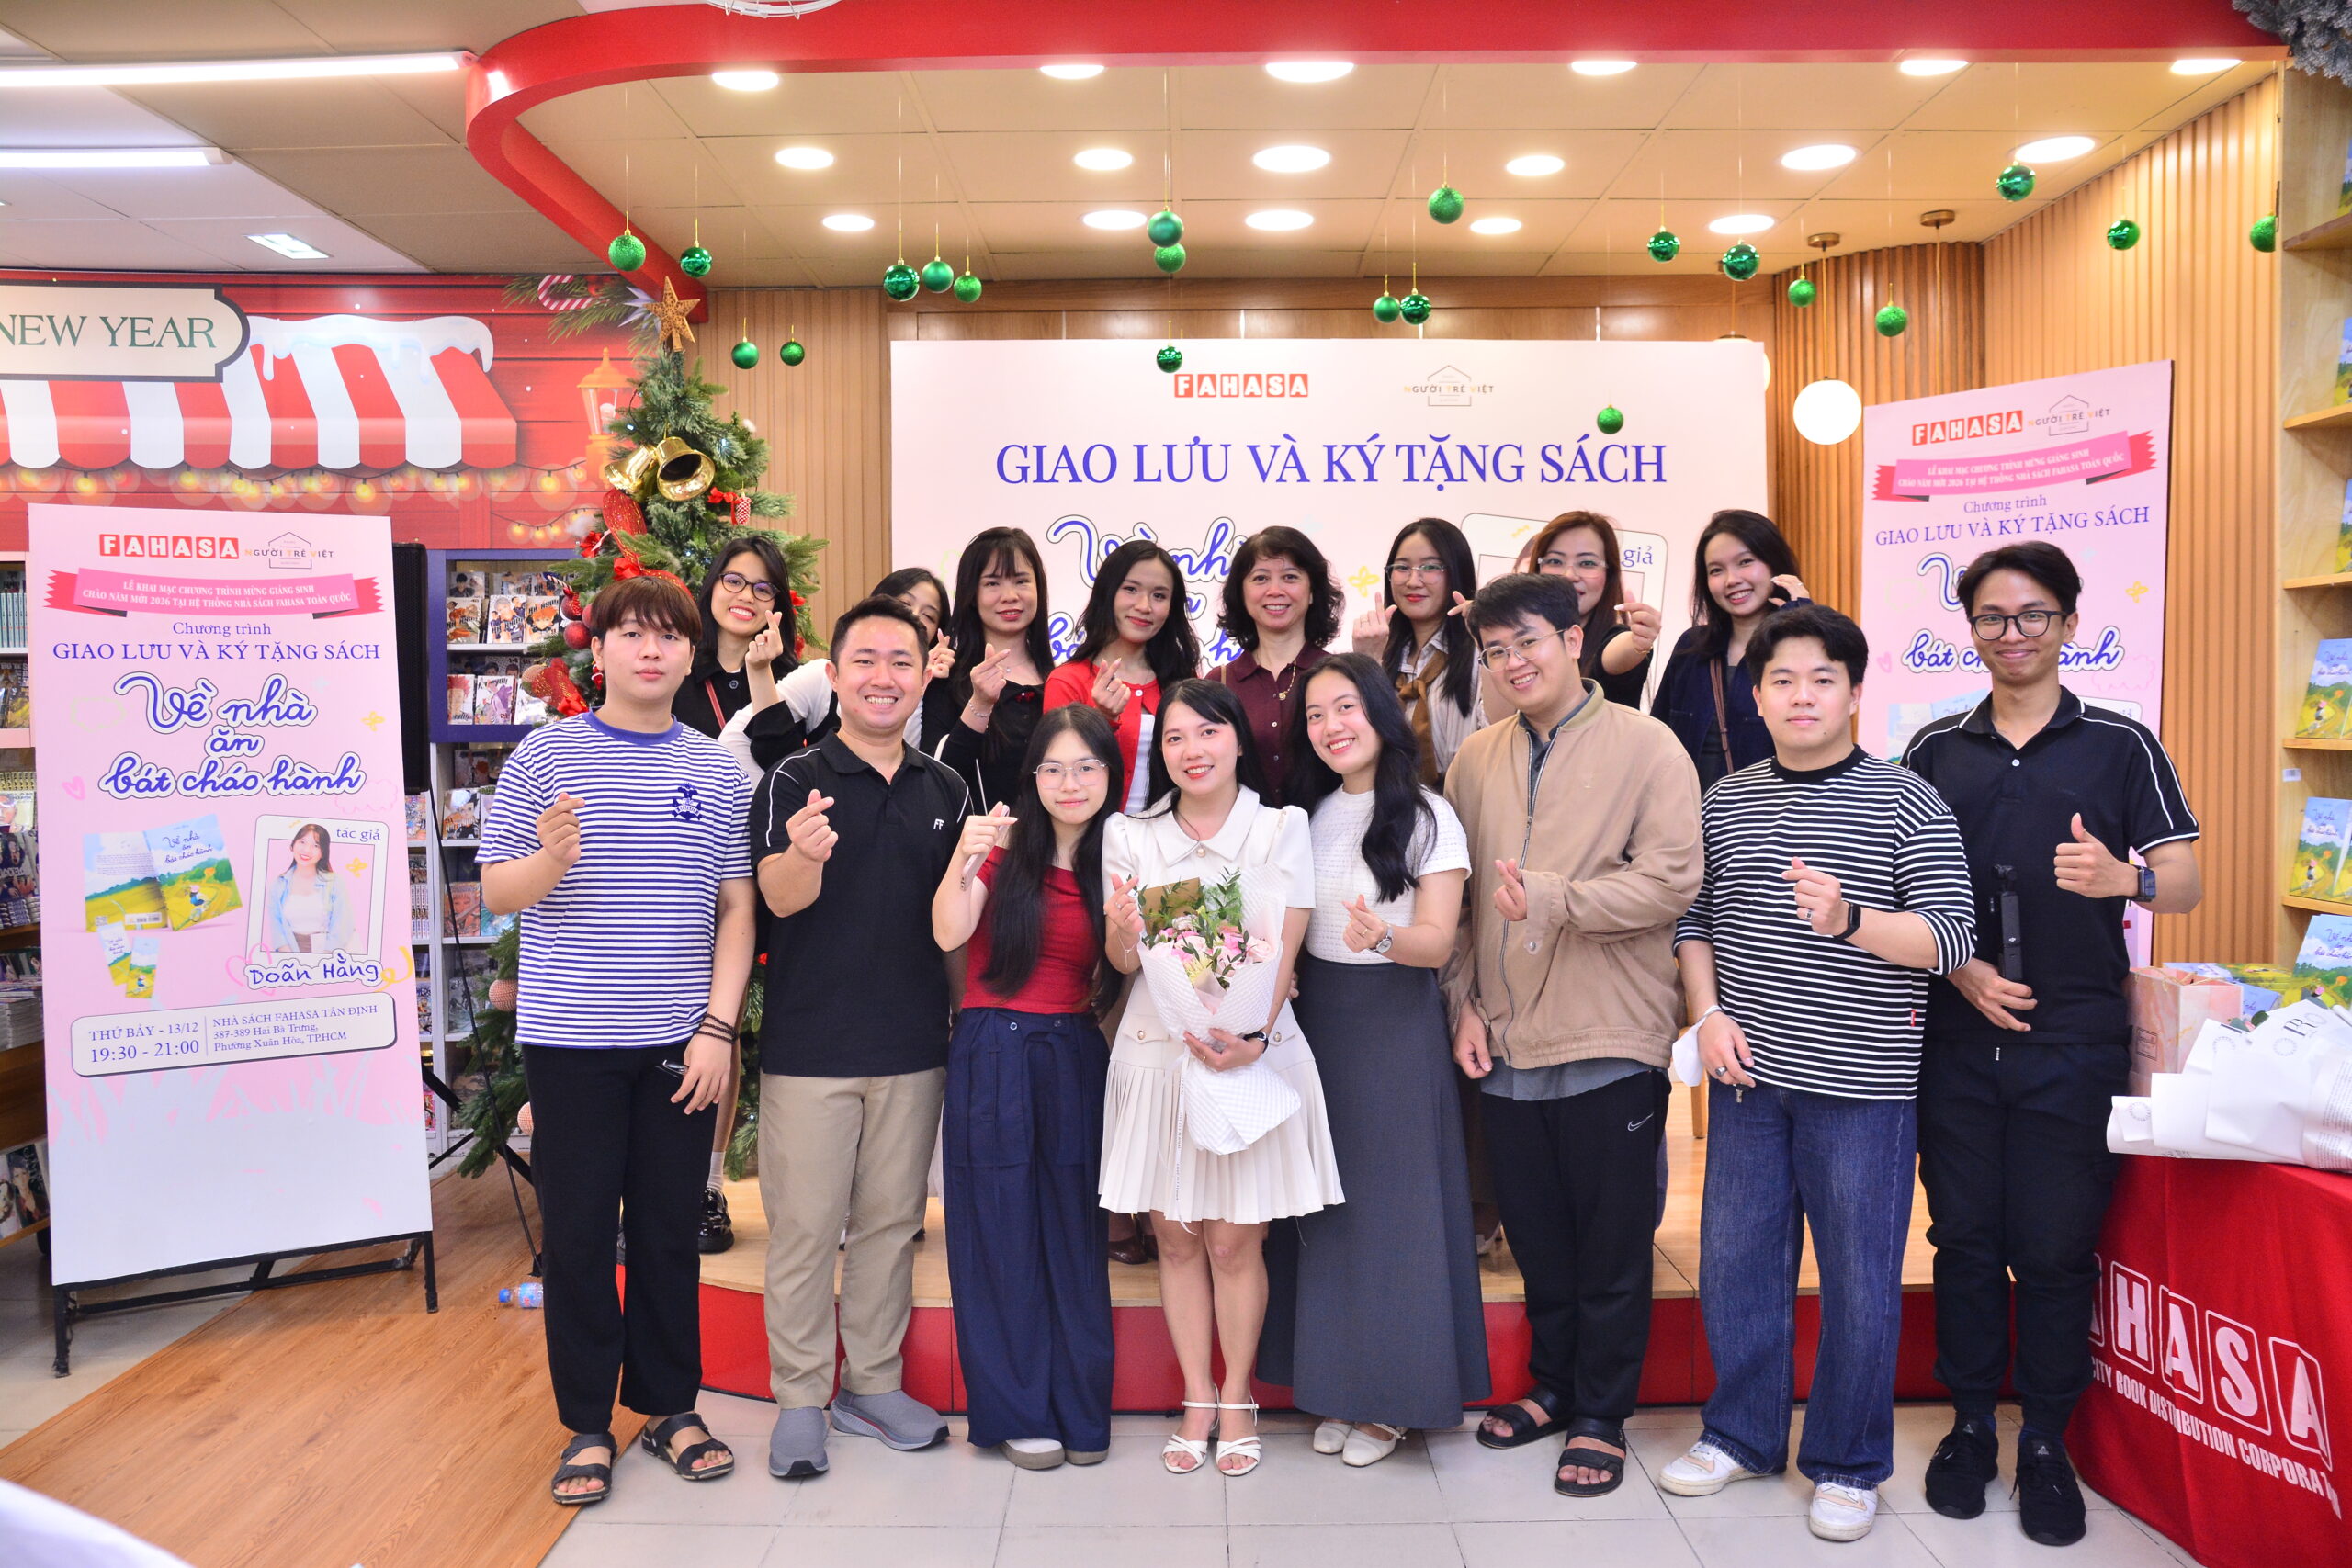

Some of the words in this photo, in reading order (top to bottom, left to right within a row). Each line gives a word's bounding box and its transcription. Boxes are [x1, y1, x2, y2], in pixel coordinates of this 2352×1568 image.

[99, 316, 217, 348] YEAR
[1175, 374, 1308, 398] FAHASA
[1913, 411, 2023, 446] FAHASA
[996, 444, 1117, 484] GIAO
[1133, 436, 1230, 484] LƯU
[1247, 433, 1310, 483] VÀ
[1322, 433, 1385, 483] KÝ
[1396, 434, 1524, 491] TẶNG
[1540, 434, 1667, 483] SÁCH
[1963, 498, 2012, 514] Chương
[2015, 494, 2047, 509] trình
[1875, 528, 1919, 547] GIAO
[1925, 522, 1962, 542] LƯU
[1968, 516, 1992, 537] VÀ
[1997, 513, 2026, 536] KÝ
[2031, 511, 2088, 536] TẶNG
[2094, 504, 2150, 527] SÁCH
[100, 535, 239, 559] FAHASA
[1621, 546, 1653, 568] giả
[82, 587, 107, 600] CHÀO
[108, 591, 128, 603] NĂM
[130, 594, 148, 604] MỚI
[150, 596, 170, 606] 2026
[173, 598, 187, 608] TẠI
[188, 597, 200, 610] HỆ
[202, 595, 232, 608] THỐNG
[234, 597, 251, 608] NHÀ
[253, 597, 273, 608] SÁCH
[275, 597, 305, 607] FAHASA
[306, 594, 328, 606] TOÀN
[329, 591, 352, 604] QUỐC
[123, 579, 134, 591] LỄ
[136, 582, 156, 592] KHAI
[159, 584, 176, 595] MẠC
[178, 585, 213, 596] CHƯƠNG
[215, 585, 242, 596] TRÌNH
[243, 584, 267, 595] MỪNG
[269, 584, 294, 595] GIÁNG
[295, 584, 314, 594] SINH
[173, 622, 231, 637] Chương
[236, 623, 272, 635] trình
[52, 642, 115, 660] GIAO
[122, 642, 172, 660] LƯU
[181, 639, 213, 660] VÀ
[216, 639, 248, 660] KÝ
[257, 640, 318, 662] TẶNG
[324, 640, 380, 660] SÁCH
[1905, 633, 1954, 667] bát
[120, 675, 212, 728] Về
[222, 677, 313, 722] nhà
[209, 728, 260, 753] ăn
[104, 755, 172, 795] bát
[183, 759, 259, 794] cháo
[266, 755, 362, 790] hành
[336, 827, 356, 840] tác
[361, 828, 381, 842] giả
[249, 963, 312, 985] Doãn
[322, 953, 379, 982] Hằng
[213, 1016, 239, 1027] NHÀ
[242, 1013, 272, 1025] SÁCH
[275, 1010, 320, 1021] FAHASA
[321, 1007, 345, 1018] TÂN
[348, 1005, 379, 1017] ĐỊNH
[88, 1025, 123, 1041] THỨ
[126, 1023, 154, 1038] BẢY
[168, 1021, 199, 1034] 13/12
[213, 1028, 251, 1039] 387-389
[254, 1026, 271, 1035] Hai
[273, 1023, 286, 1034] Bà
[288, 1022, 319, 1033] Trưng,
[214, 1040, 252, 1052] Phường
[254, 1038, 280, 1048] Xuân
[306, 1031, 347, 1043] TP.HCM
[91, 1044, 138, 1063] 19:30
[153, 1039, 199, 1057] 21:00
[2090, 1273, 2329, 1459] HASA
[2116, 1369, 2147, 1410] BOOK
